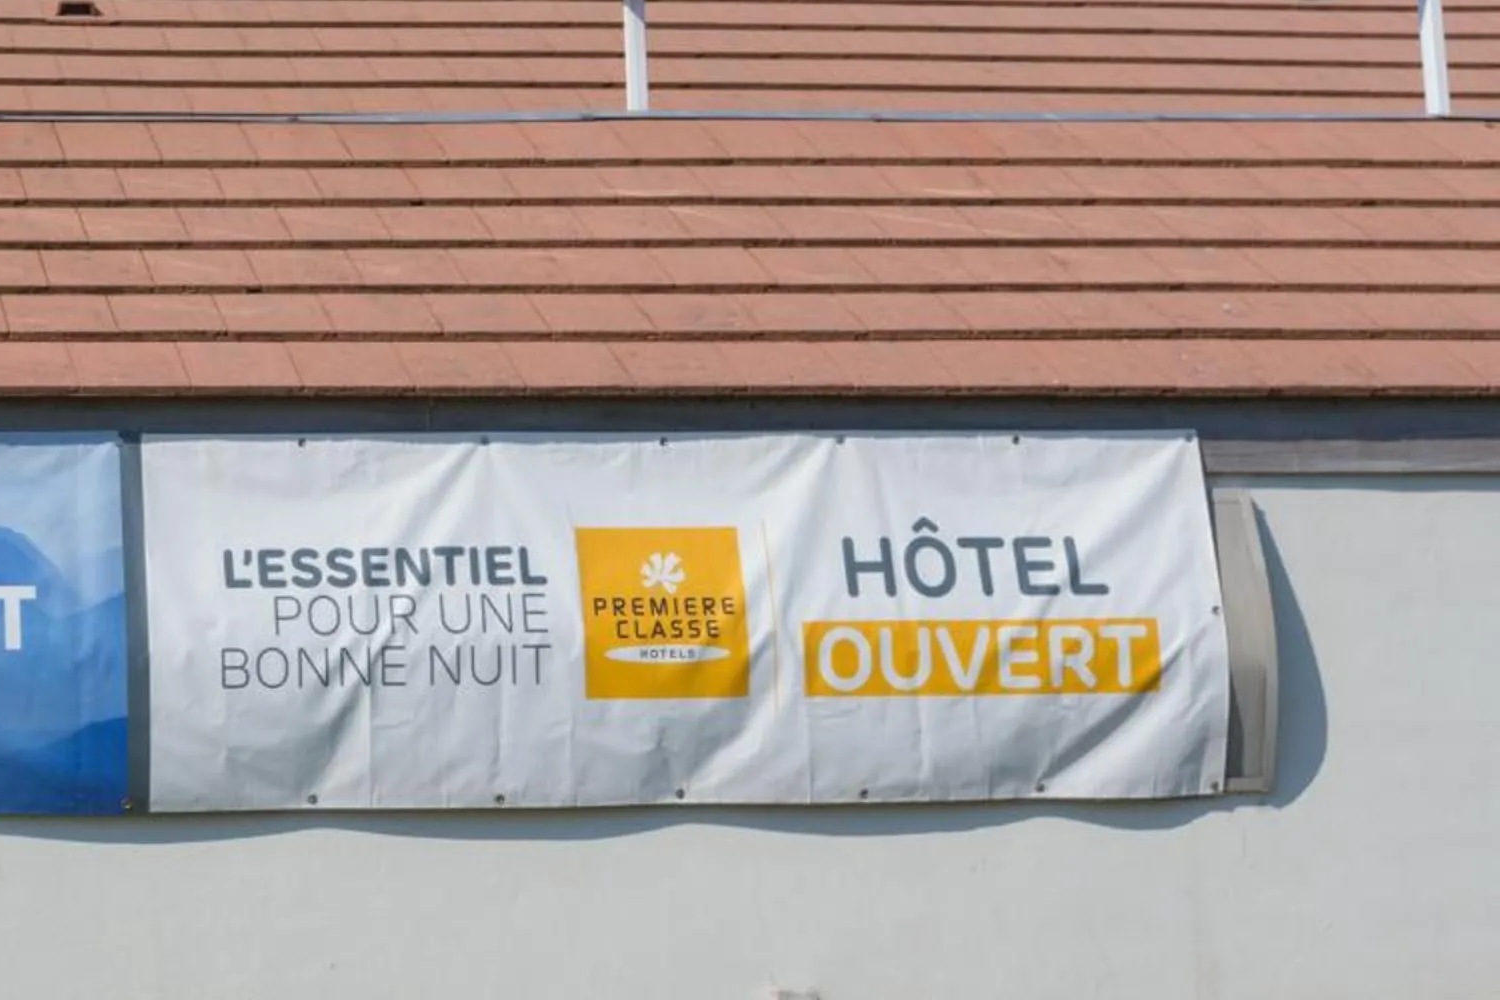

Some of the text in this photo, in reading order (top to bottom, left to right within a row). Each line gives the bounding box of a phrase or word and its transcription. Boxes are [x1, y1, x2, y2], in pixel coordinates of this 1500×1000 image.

[222, 545, 548, 589] L'ESSENTIEL
[841, 516, 1110, 598] HÔTEL
[273, 592, 549, 637] POUR UNE
[592, 597, 736, 617] PREMIERE
[616, 619, 721, 640] CLASSE
[220, 644, 552, 690] BONNE NUIT
[639, 648, 696, 660] HOTELS
[817, 624, 1148, 692] OUVERT
